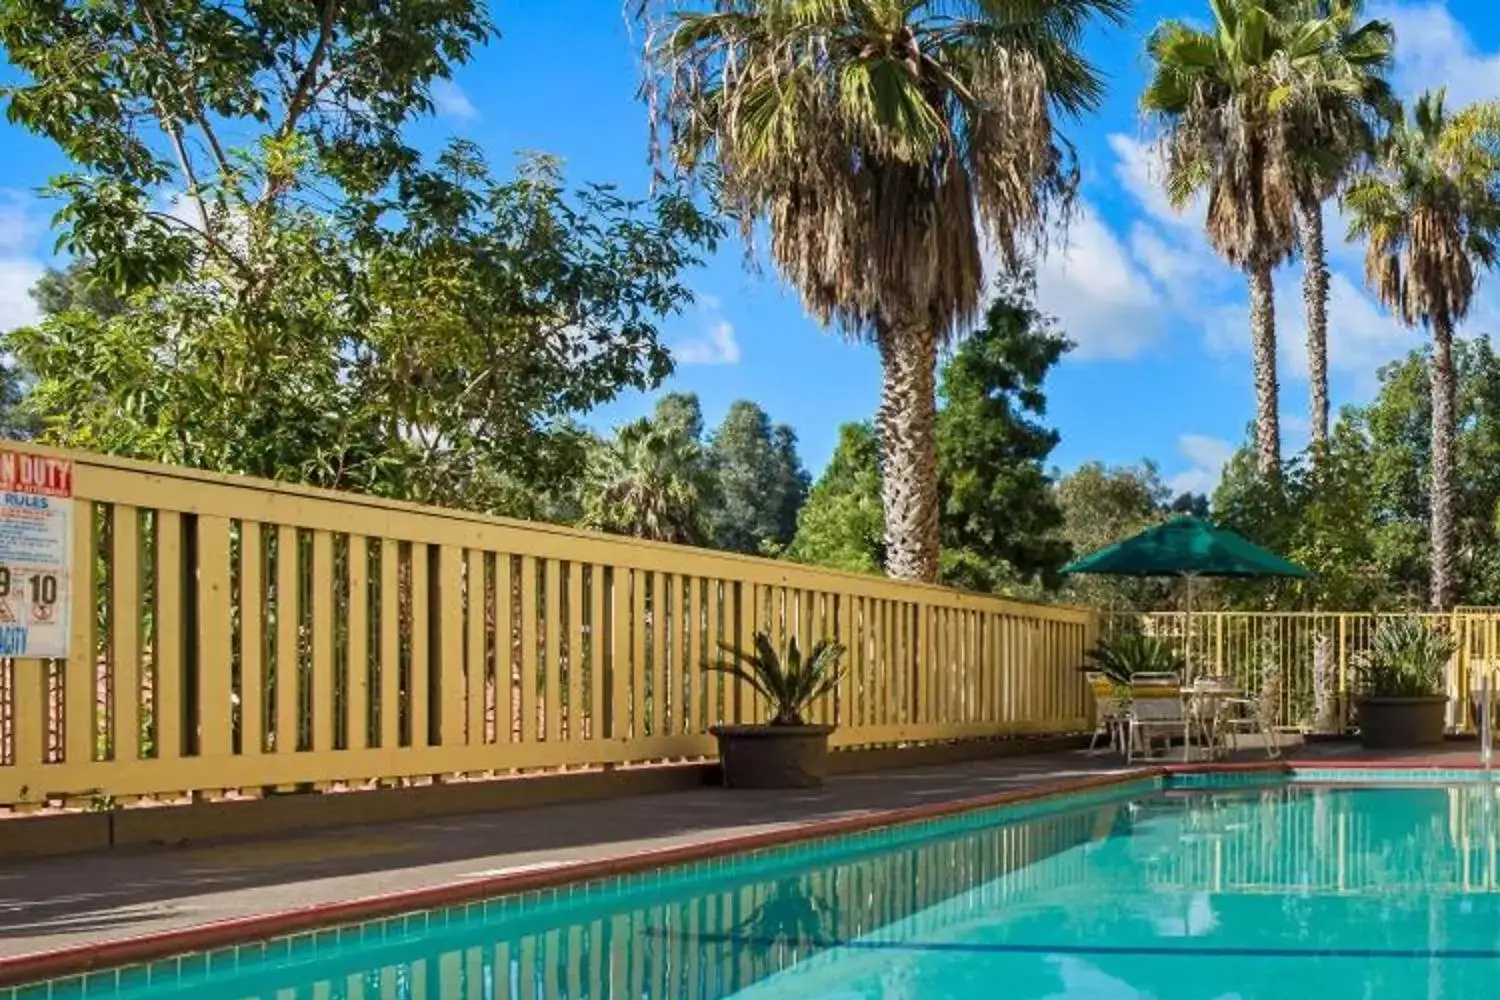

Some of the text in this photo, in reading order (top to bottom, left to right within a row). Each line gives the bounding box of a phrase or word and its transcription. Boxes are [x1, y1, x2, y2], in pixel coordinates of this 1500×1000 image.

[20, 455, 71, 491] DUTY
[5, 493, 48, 509] RULES
[29, 574, 57, 604] 10
